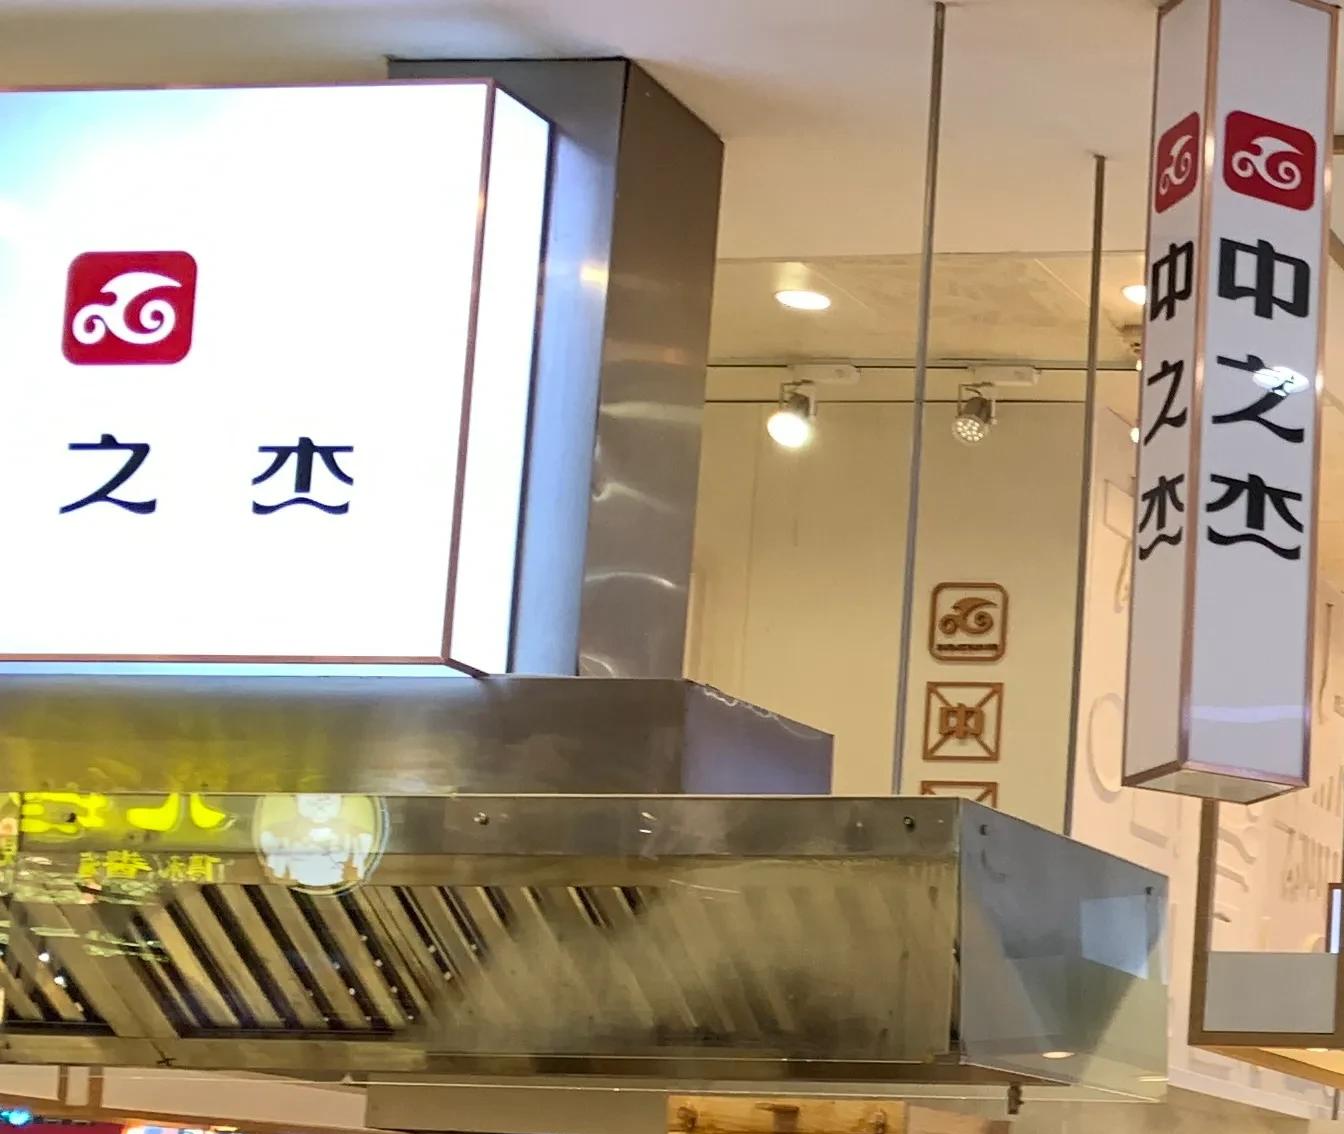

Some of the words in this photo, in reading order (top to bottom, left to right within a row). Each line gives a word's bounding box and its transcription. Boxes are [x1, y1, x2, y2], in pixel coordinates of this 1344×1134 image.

[1139, 239, 1194, 561] 中之杰
[1205, 237, 1311, 561] 中之杰
